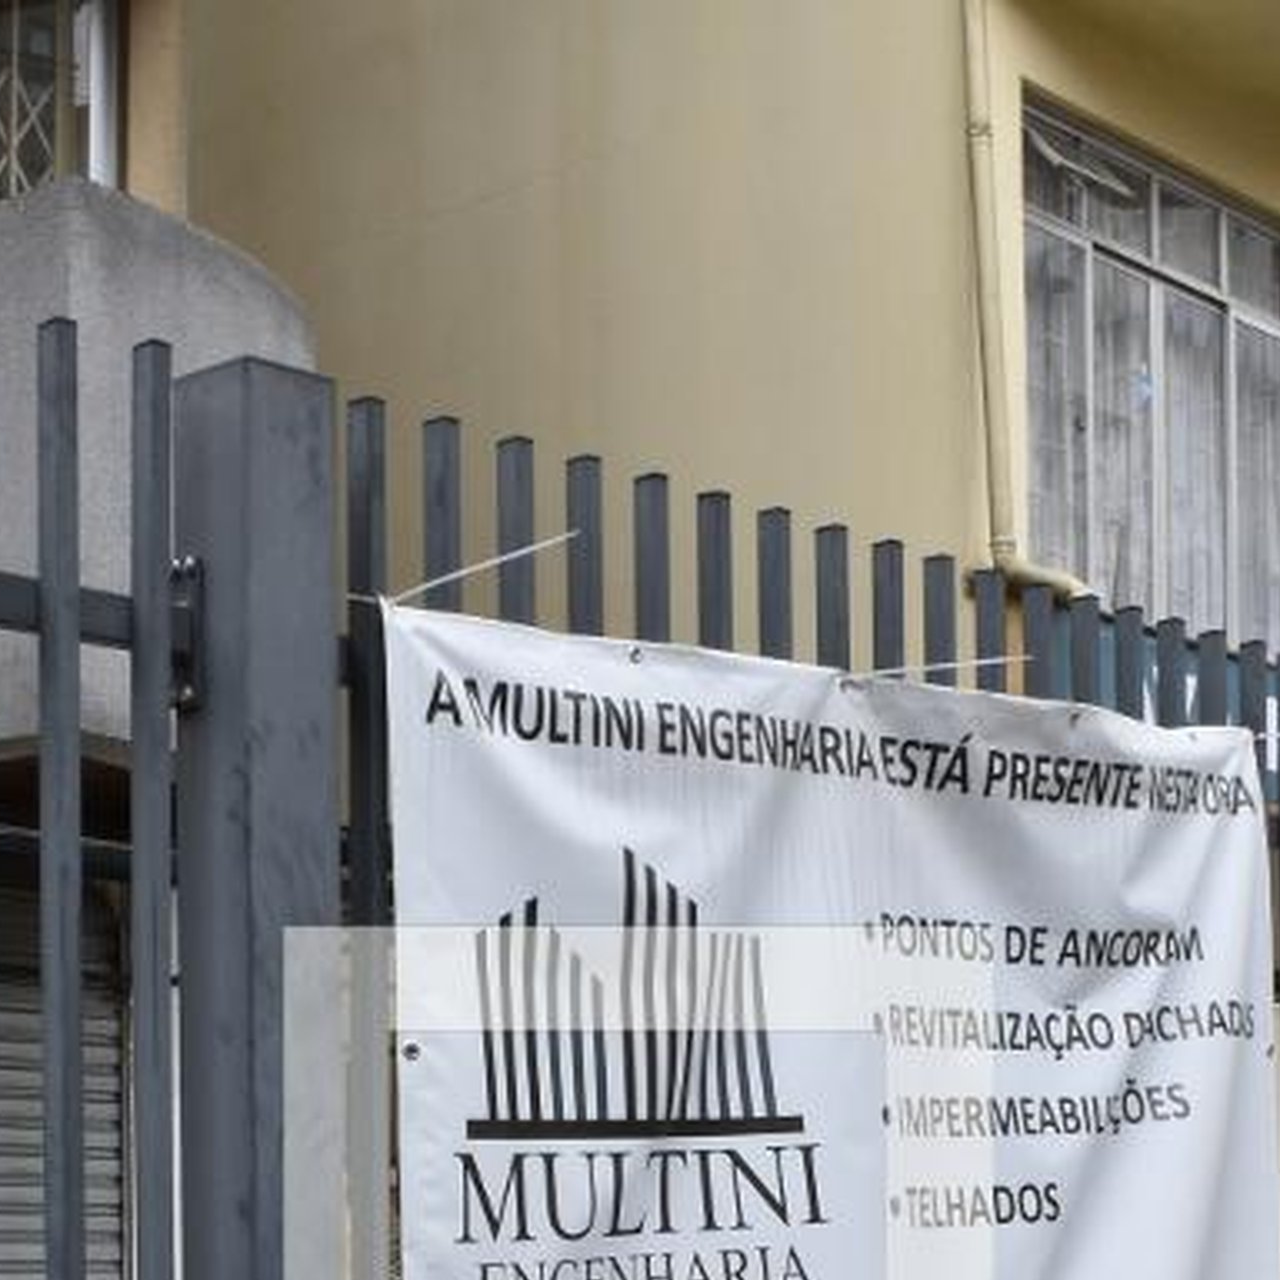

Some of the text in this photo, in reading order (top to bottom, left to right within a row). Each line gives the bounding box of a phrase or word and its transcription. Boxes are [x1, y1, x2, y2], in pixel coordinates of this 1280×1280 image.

[426, 669, 463, 728] A
[462, 678, 645, 751] MULTINI
[658, 702, 880, 782] ENGENHARIA
[880, 732, 973, 794] ESTÁ
[983, 750, 1144, 811] PRESENTE
[880, 912, 995, 963] PONTOS
[1005, 925, 1049, 966] DE
[888, 1003, 1115, 1060] REVITALIZAÇÃO
[453, 1142, 831, 1245] MULTINI
[904, 1182, 1061, 1228] TELHADOS
